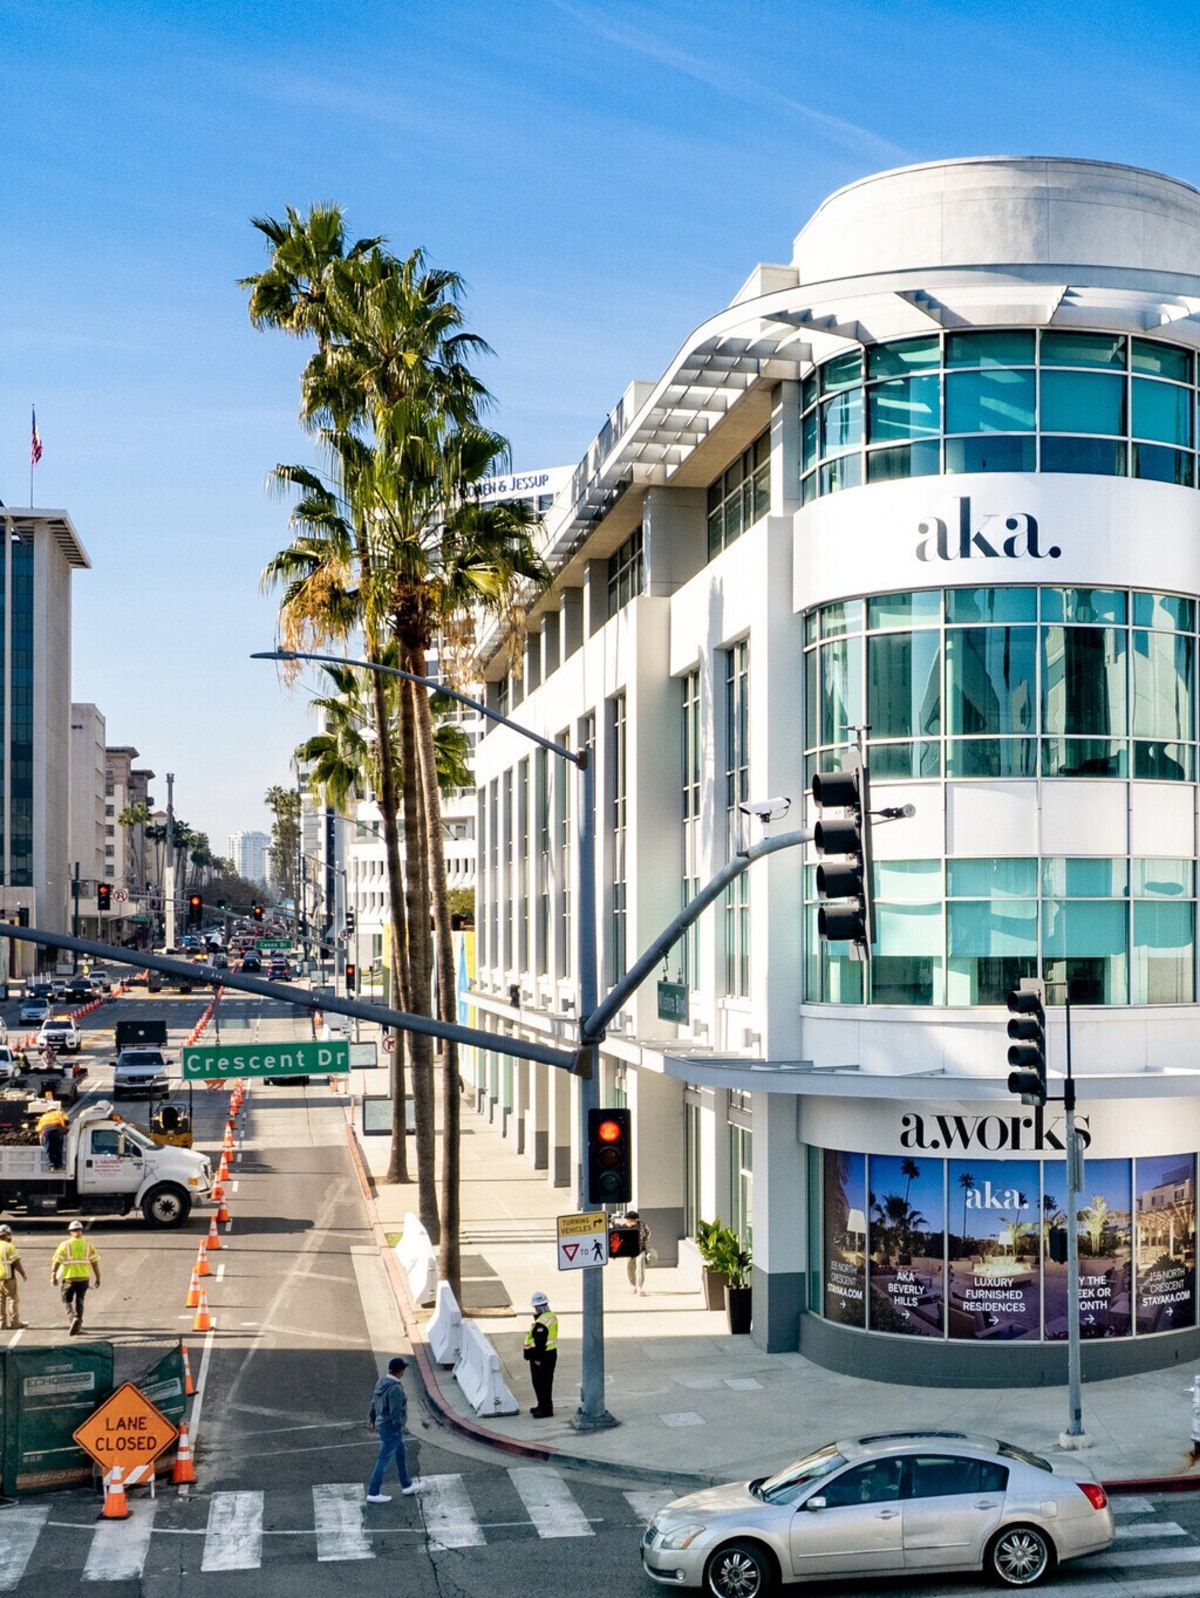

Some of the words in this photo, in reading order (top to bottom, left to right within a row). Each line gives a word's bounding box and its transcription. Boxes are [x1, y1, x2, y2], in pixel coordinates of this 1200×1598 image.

[498, 480, 507, 493] &
[509, 473, 549, 492] JESSUP
[915, 495, 1062, 562] aka.
[186, 1050, 305, 1072] Crescent
[317, 1049, 346, 1067] Dr
[965, 1180, 1030, 1210] aka.
[562, 1217, 590, 1227] TURNING
[560, 1224, 592, 1235] VEHICLES
[580, 1248, 589, 1256] TO
[896, 1271, 915, 1282] AKA
[1087, 1275, 1107, 1286] THE
[1149, 1270, 1162, 1282] 155
[1162, 1267, 1186, 1279] NORTH
[887, 1282, 926, 1295] BEVERLY
[974, 1277, 1015, 1288] LUXURY
[1150, 1279, 1185, 1294] CRESCENT
[965, 1289, 1024, 1300] FURNISHED
[1096, 1287, 1112, 1298] OR
[894, 1295, 919, 1307] HILLS
[1142, 1290, 1191, 1308] STAYAKA.COM
[962, 1301, 1026, 1313] RESIDENCES
[1078, 1300, 1108, 1311] ONTH
[105, 1416, 148, 1432] LANE
[94, 1435, 158, 1451] CLOSED
